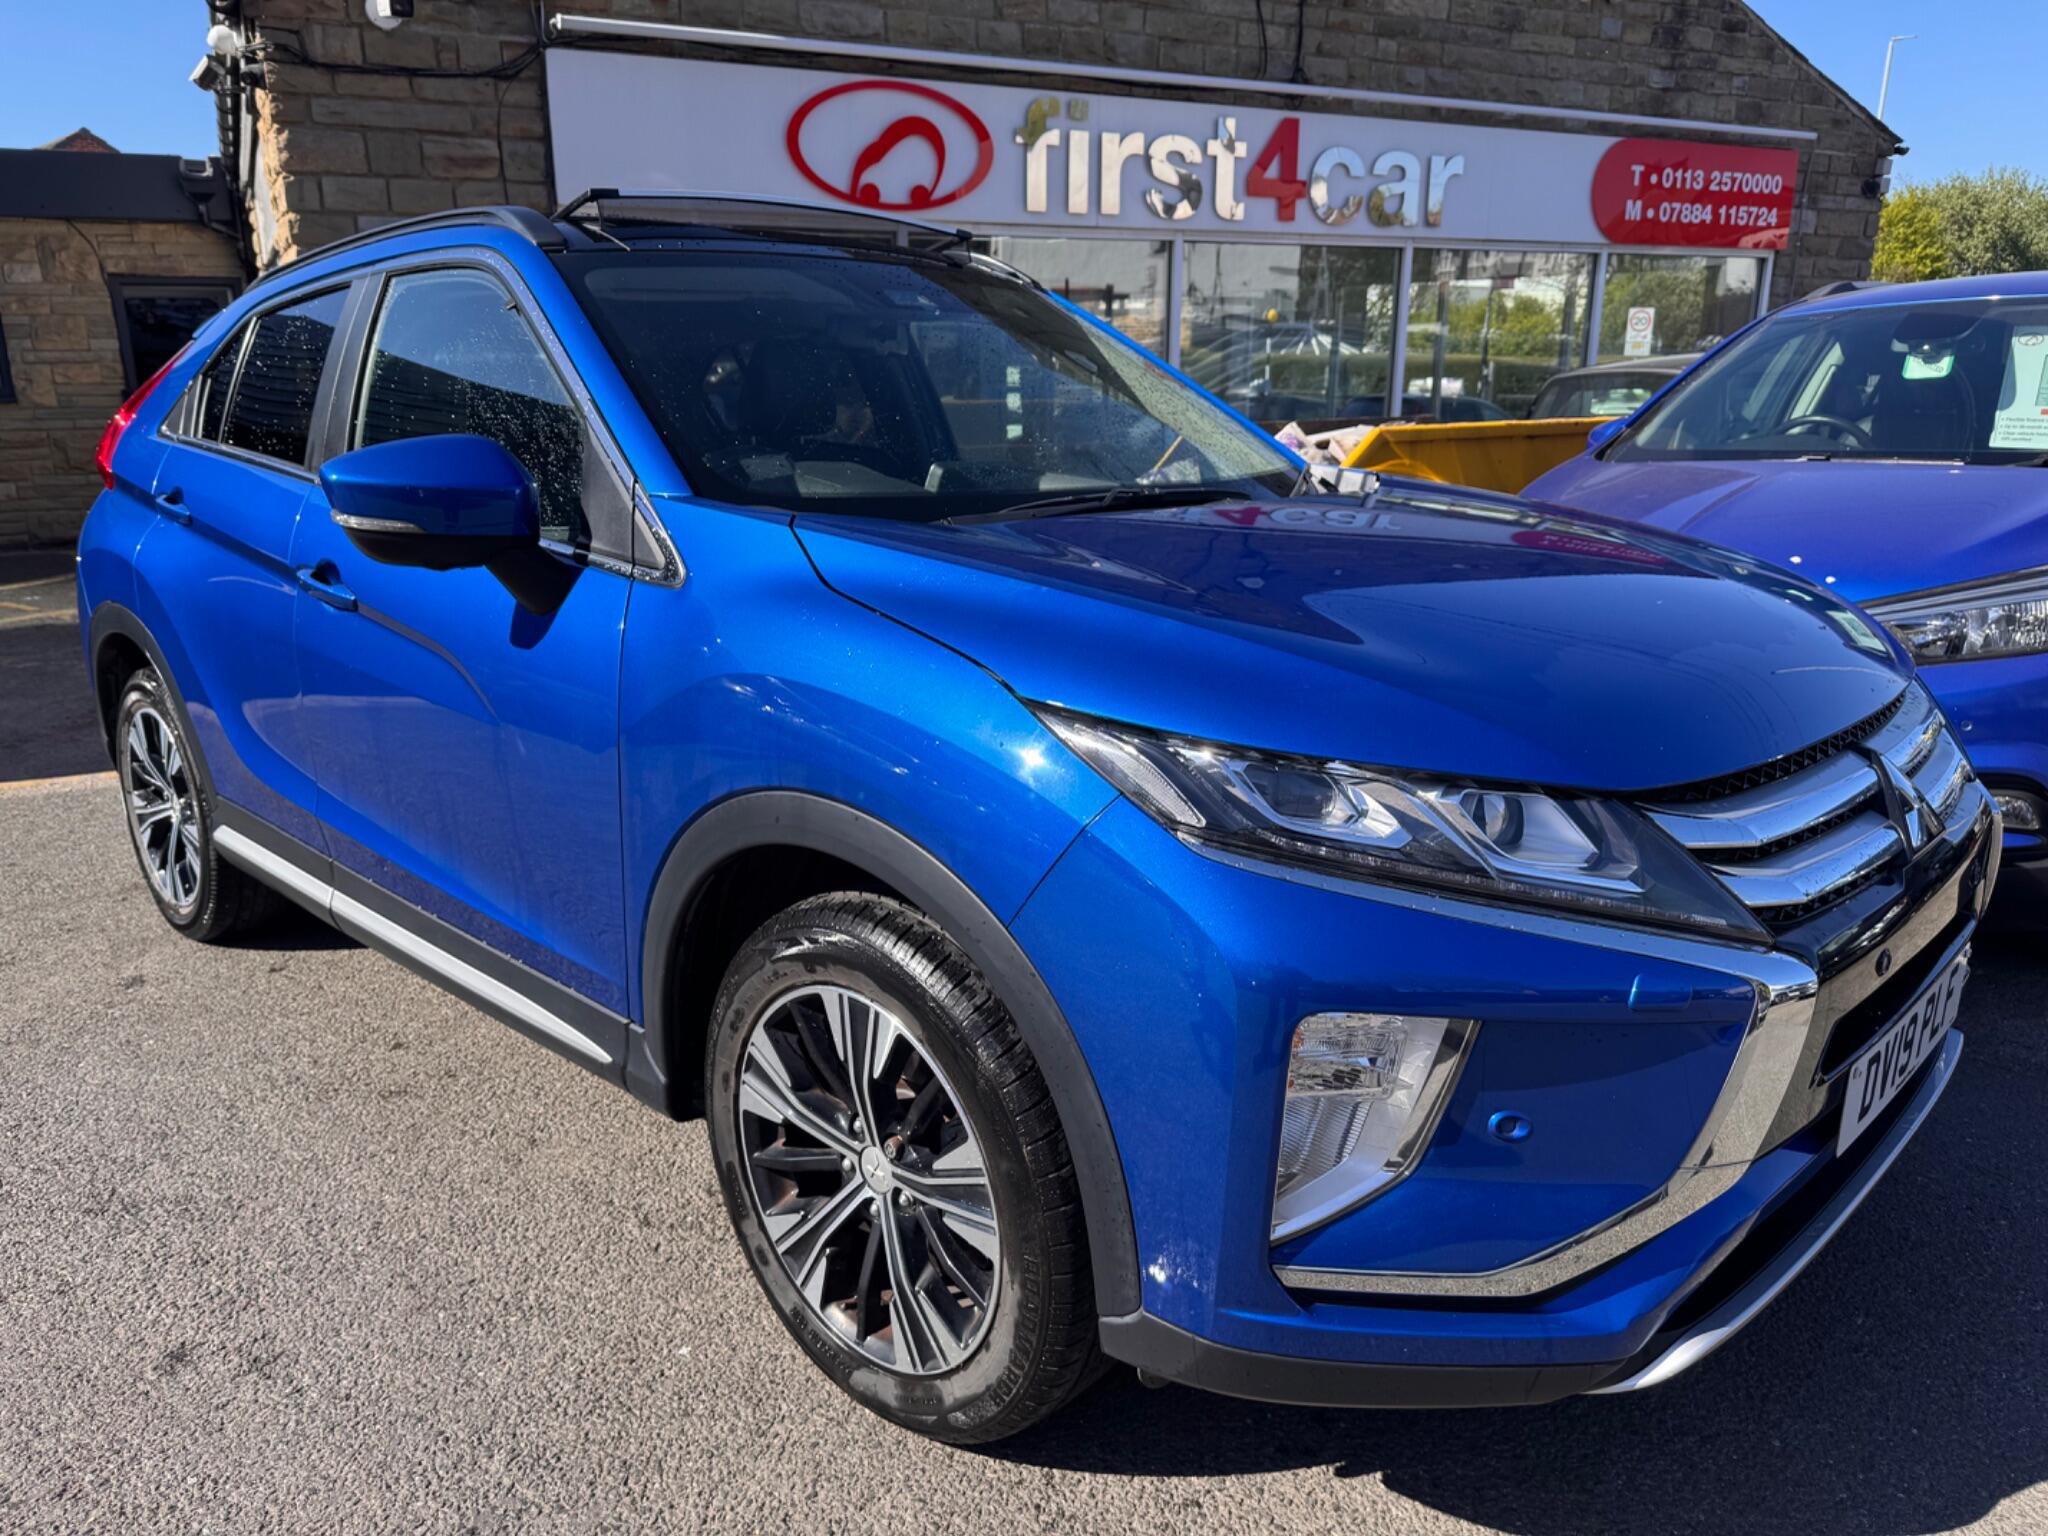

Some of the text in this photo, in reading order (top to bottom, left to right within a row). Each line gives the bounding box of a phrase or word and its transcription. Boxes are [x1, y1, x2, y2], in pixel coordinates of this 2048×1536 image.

[1014, 96, 1465, 228] first4car
[1630, 164, 1783, 195] T 0113 2570000
[1624, 199, 1778, 227] M 07884 115724
[1856, 963, 1961, 1124] DV19 PLF
